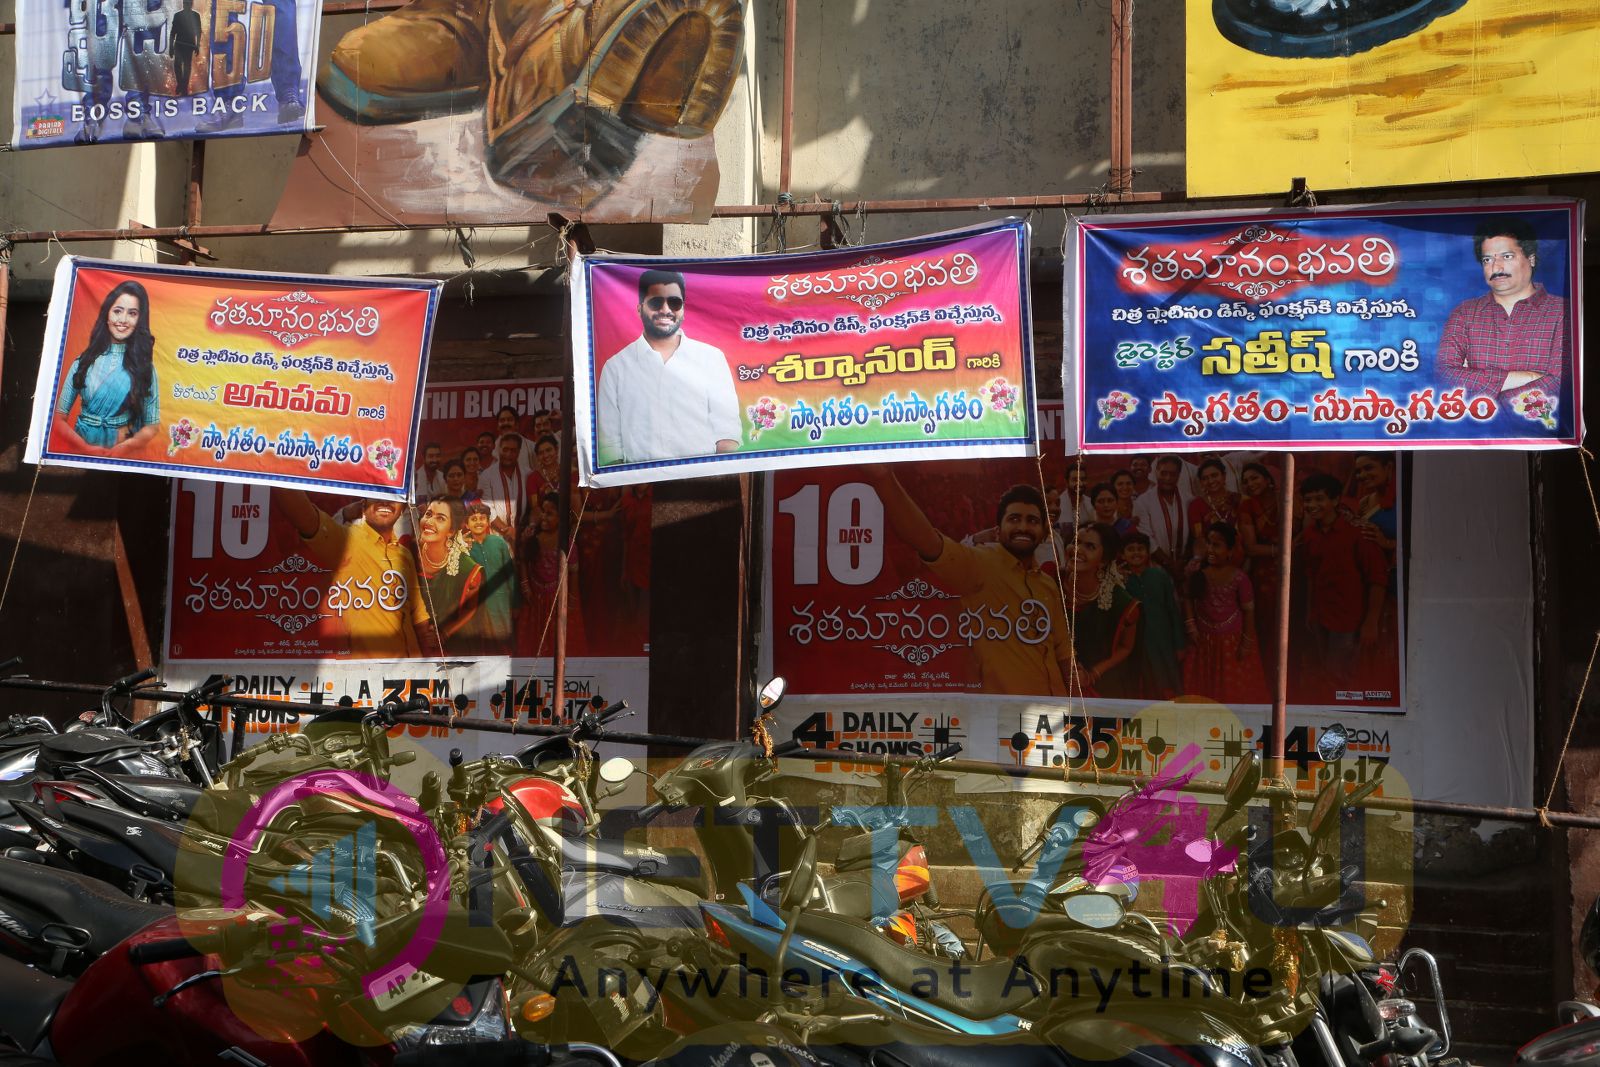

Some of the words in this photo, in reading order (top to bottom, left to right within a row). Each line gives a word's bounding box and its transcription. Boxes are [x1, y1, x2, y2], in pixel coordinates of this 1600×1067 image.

[71, 102, 141, 122] BOSS
[155, 99, 178, 117] IS
[192, 94, 268, 115] BACK
[768, 262, 898, 301] శతమానం
[902, 252, 979, 294] భవతి
[1123, 245, 1289, 287] శతమానం
[1297, 236, 1397, 283] భవతి
[210, 297, 315, 331] శతమానం
[318, 305, 379, 338] భవతి
[742, 325, 770, 342] చిత్ర
[772, 319, 829, 342] ప్లాటినం
[1111, 308, 1143, 324] చిత్ర
[1147, 304, 1213, 325] ప్లాటినం
[177, 347, 200, 363] చిత్ర
[202, 349, 249, 368] ప్లాటినం
[738, 363, 764, 381] హీరో
[768, 338, 956, 387] శర్వానంద్
[966, 352, 1001, 370] గారికి
[1202, 330, 1335, 379] సతీష్
[1345, 341, 1420, 373] గారికి
[223, 381, 352, 416] అనుపమ
[357, 405, 385, 420] గారికి
[180, 479, 270, 559] 10
[231, 504, 260, 520] DAYS
[778, 483, 884, 587] 10
[838, 528, 873, 545] DAYS
[184, 572, 321, 613] శతమానం
[327, 569, 408, 617] భవతి
[789, 601, 949, 646] శతమానం
[957, 598, 1052, 647] భవతి
[236, 675, 296, 696] DAILY
[793, 712, 834, 750] 4
[843, 712, 919, 732] DAILY
[1064, 715, 1120, 770] 35
[386, 974, 407, 999] AP
